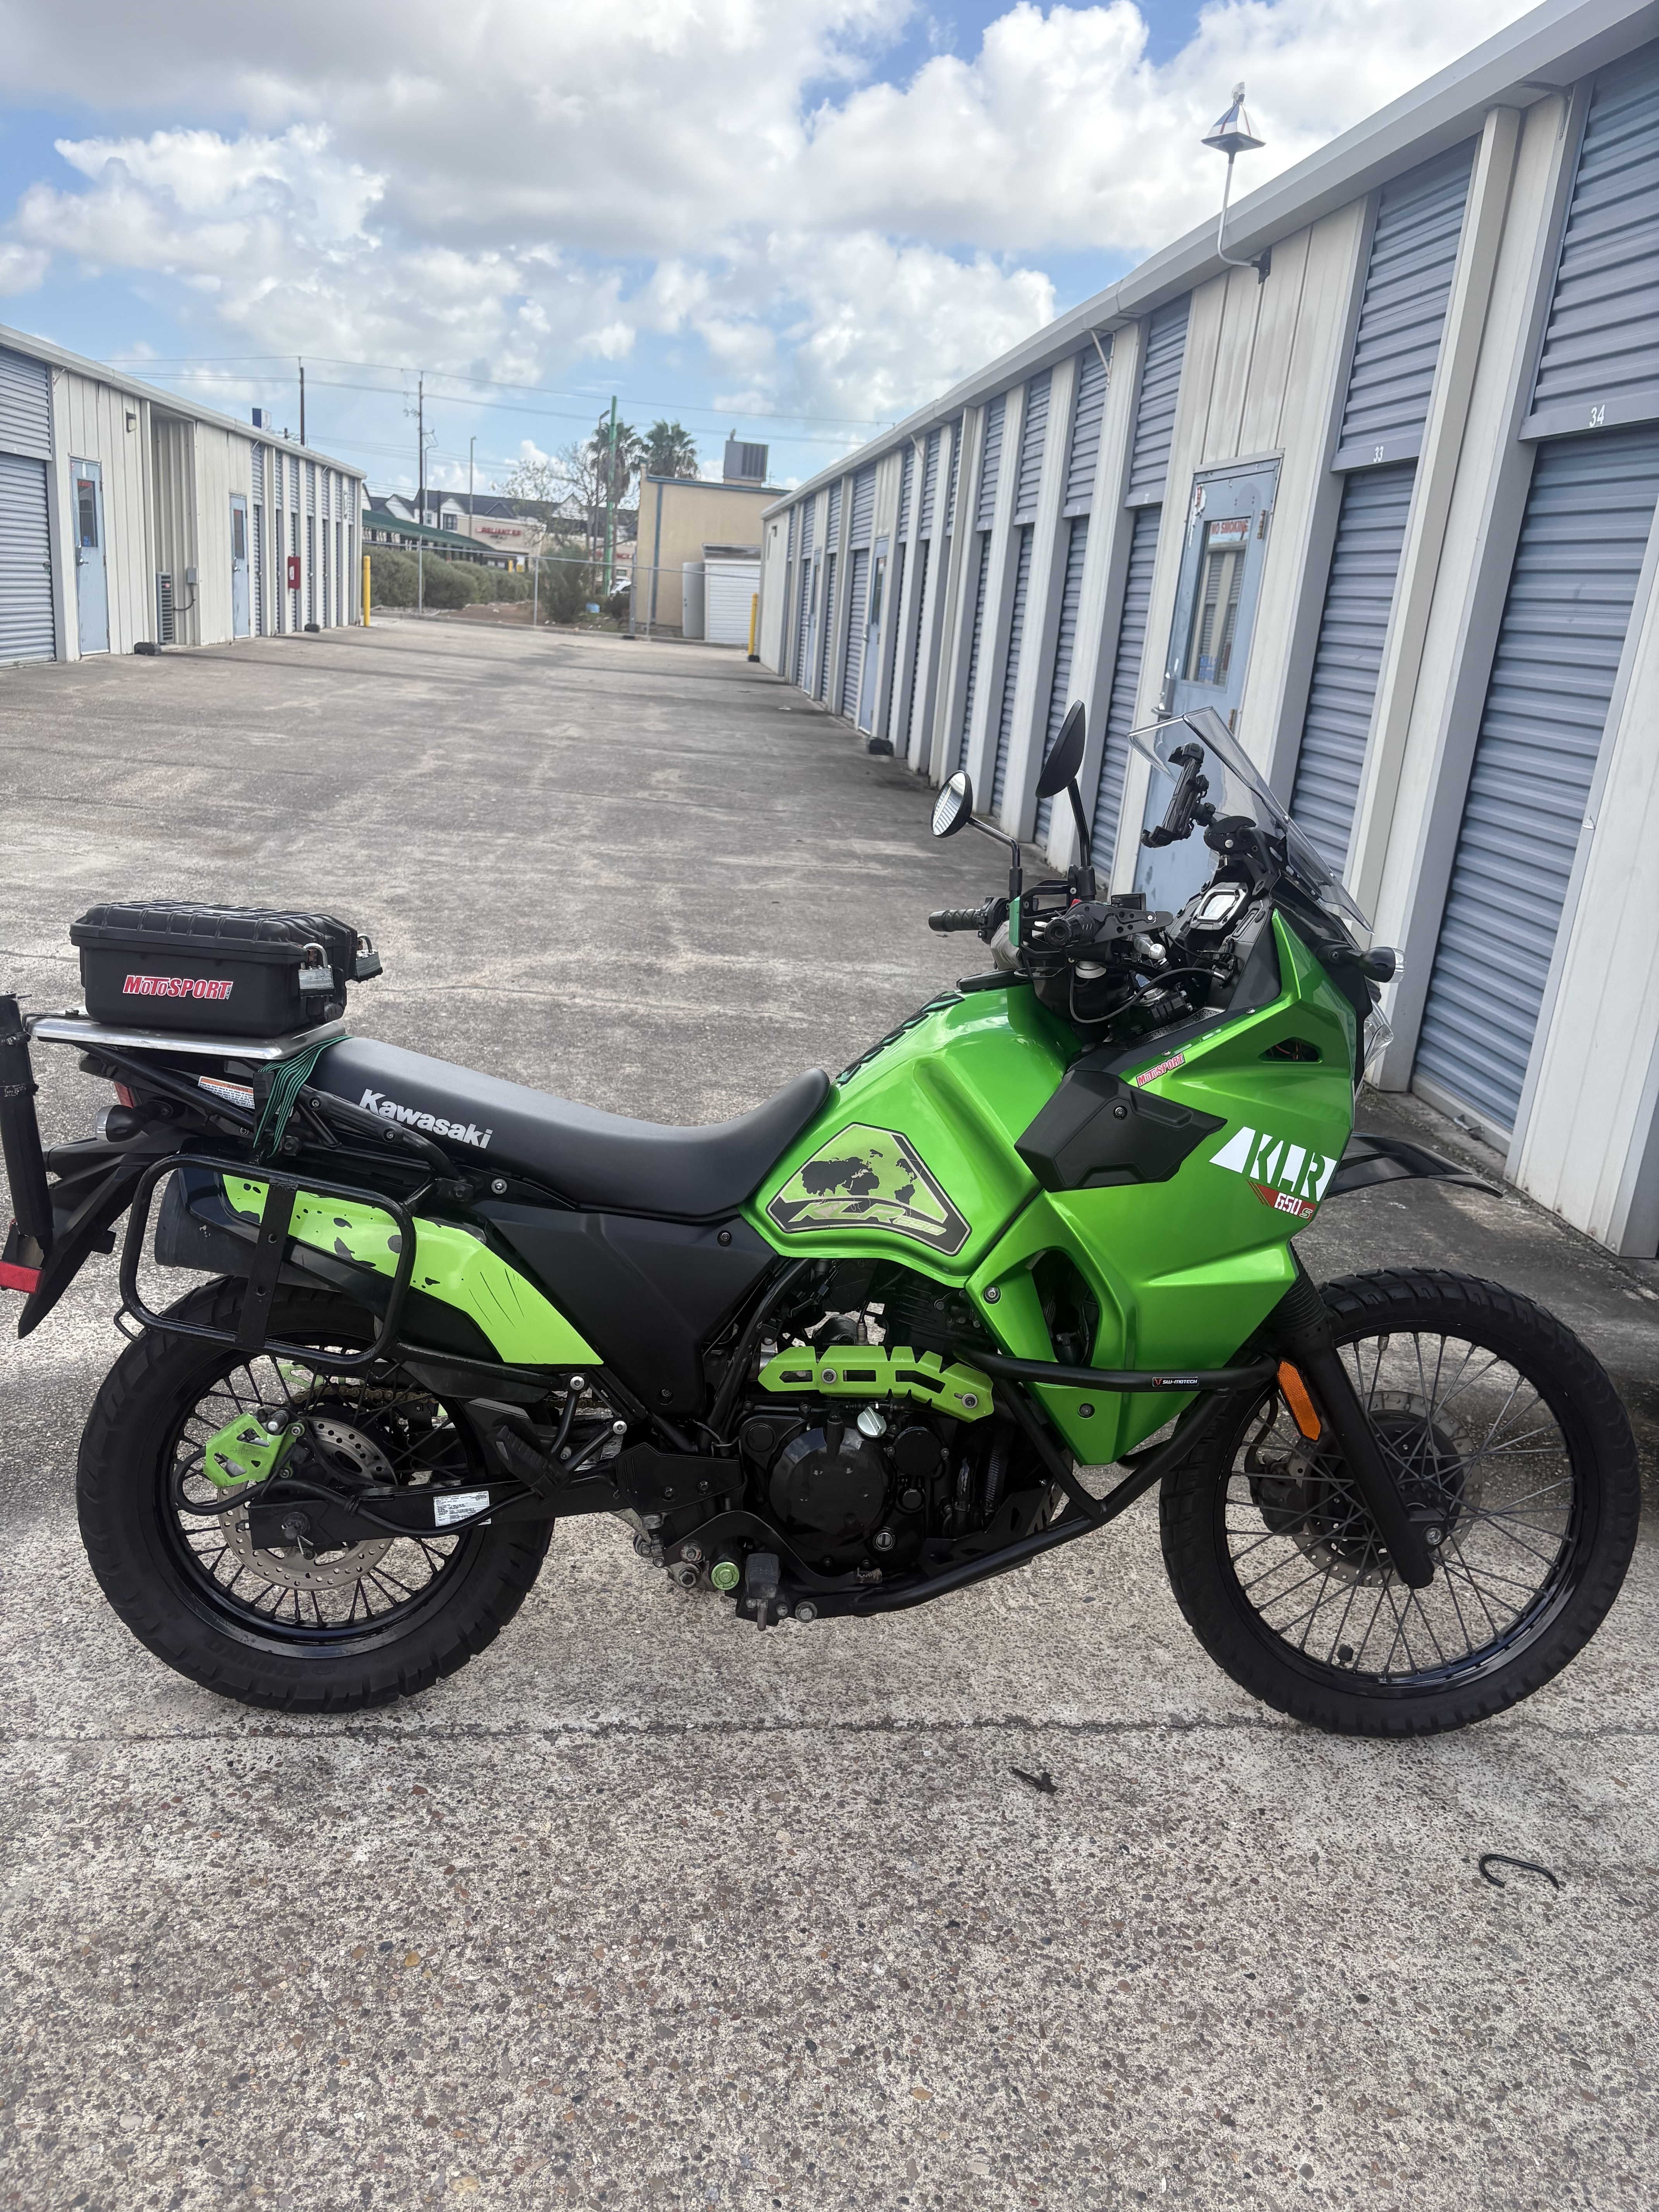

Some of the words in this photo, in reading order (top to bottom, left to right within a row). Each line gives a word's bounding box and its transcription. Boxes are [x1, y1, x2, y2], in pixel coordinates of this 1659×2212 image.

[1589, 404, 1605, 428] 34
[1373, 446, 1384, 462] 33
[227, 1084, 248, 1092] WARNING
[359, 1089, 493, 1149] Kawasaki
[1237, 1129, 1329, 1202] KLR
[1274, 1192, 1302, 1216] 650
[788, 1200, 905, 1223] KLR
[893, 1215, 947, 1236] 650
